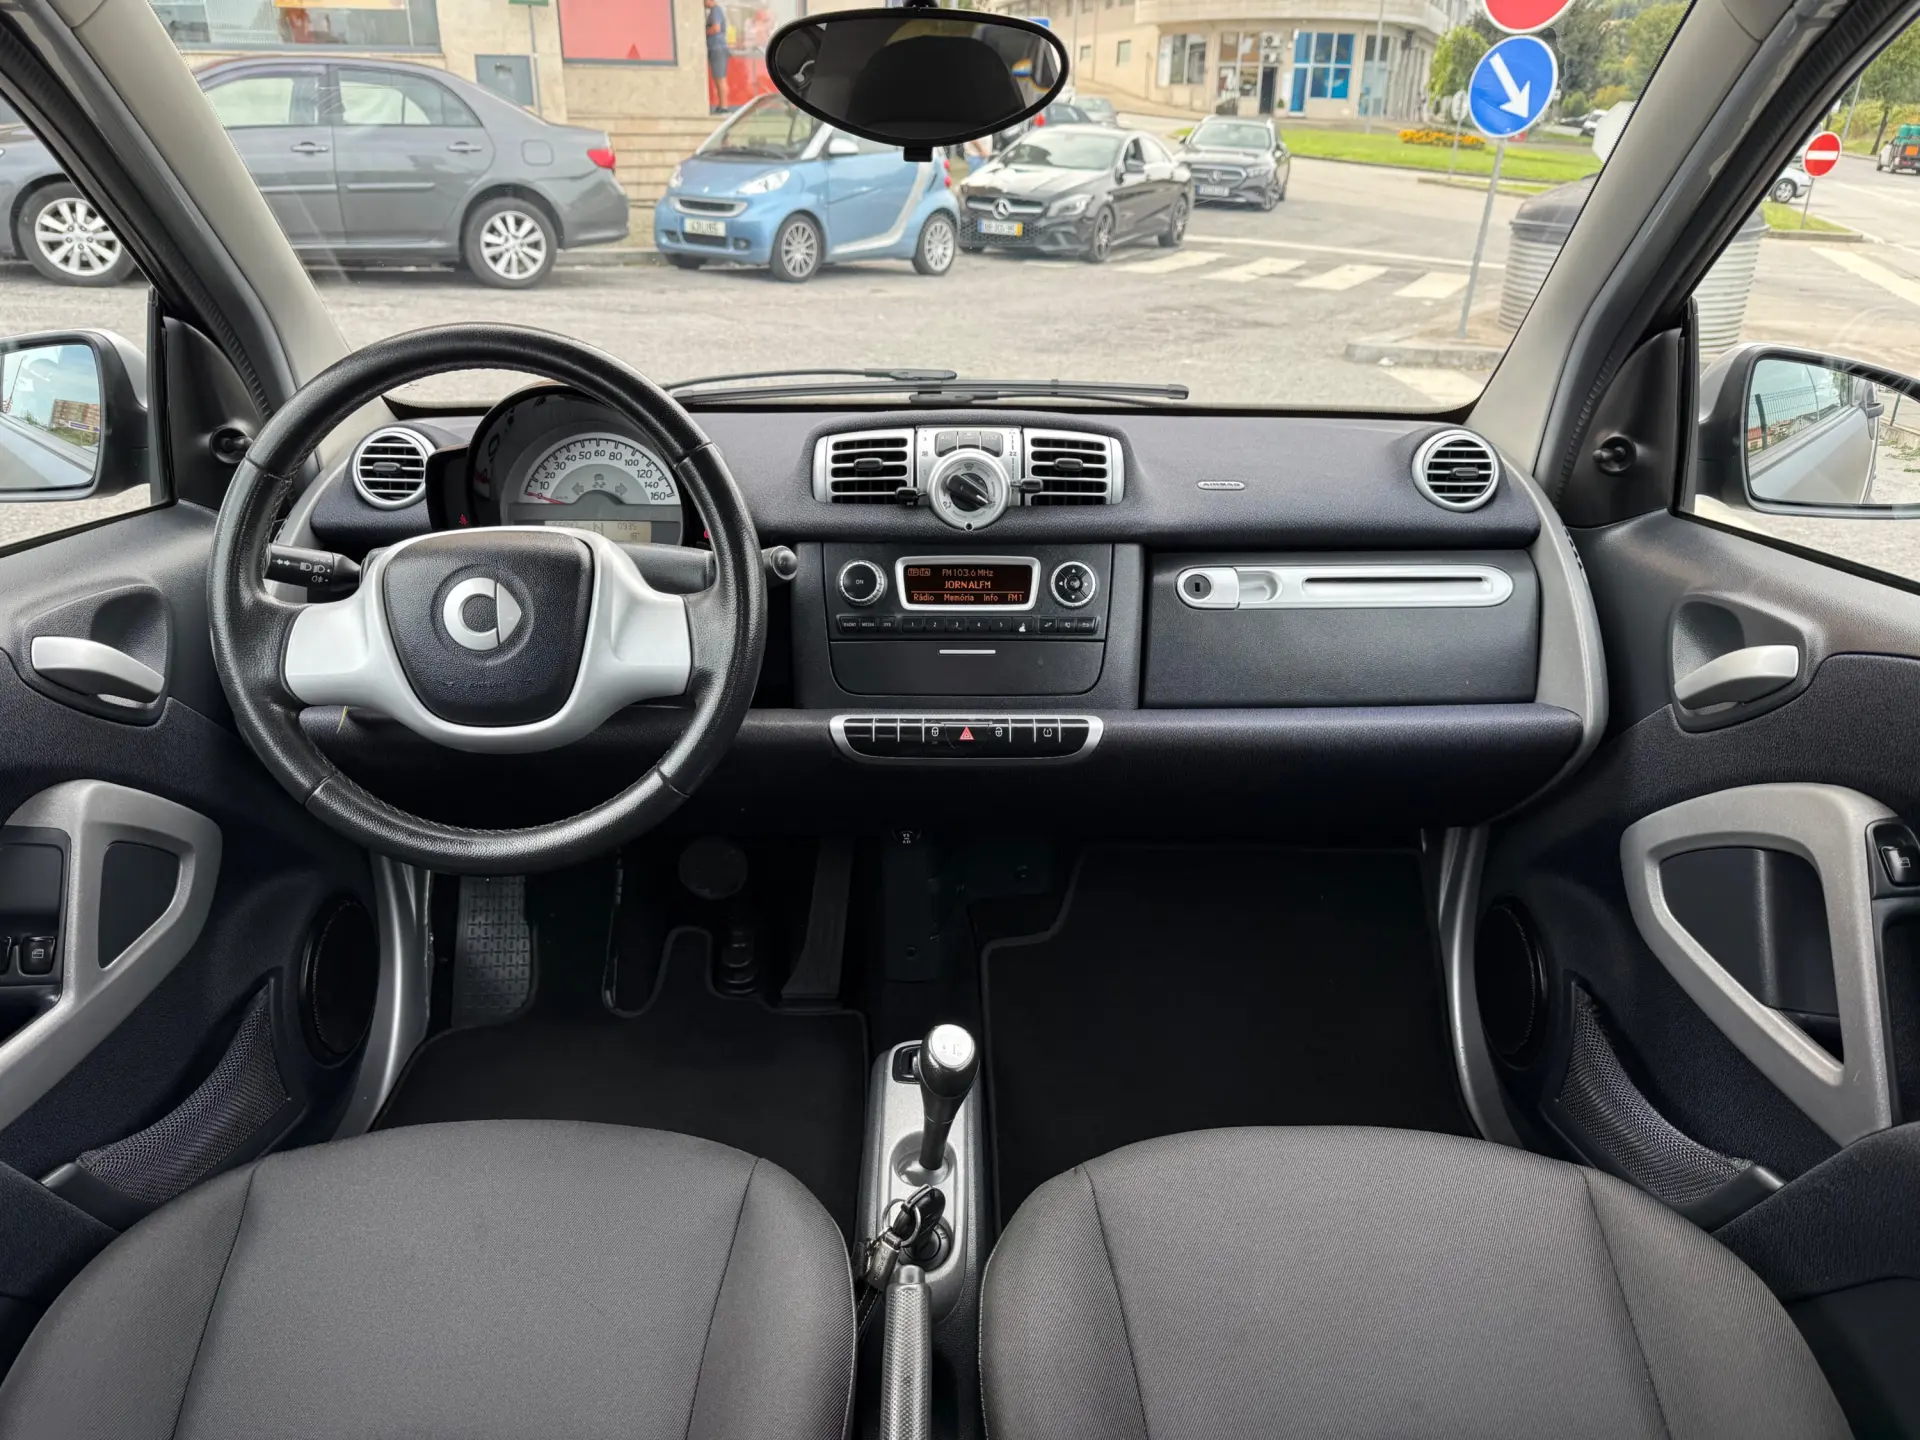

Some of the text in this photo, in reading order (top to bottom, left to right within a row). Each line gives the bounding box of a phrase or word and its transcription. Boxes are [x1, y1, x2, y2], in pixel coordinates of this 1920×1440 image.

[578, 451, 592, 460] 50
[594, 449, 606, 457] 60
[608, 451, 623, 461] 80
[565, 454, 577, 462] 40
[553, 461, 566, 470] 30
[637, 470, 653, 479] 120
[539, 481, 550, 490] 10
[644, 481, 659, 489] 140
[650, 491, 666, 500] 160
[978, 569, 994, 577] MHz
[944, 580, 991, 589] JORNALFM
[913, 593, 935, 602] Rádio
[943, 593, 975, 602] Memória
[983, 593, 999, 602] Info
